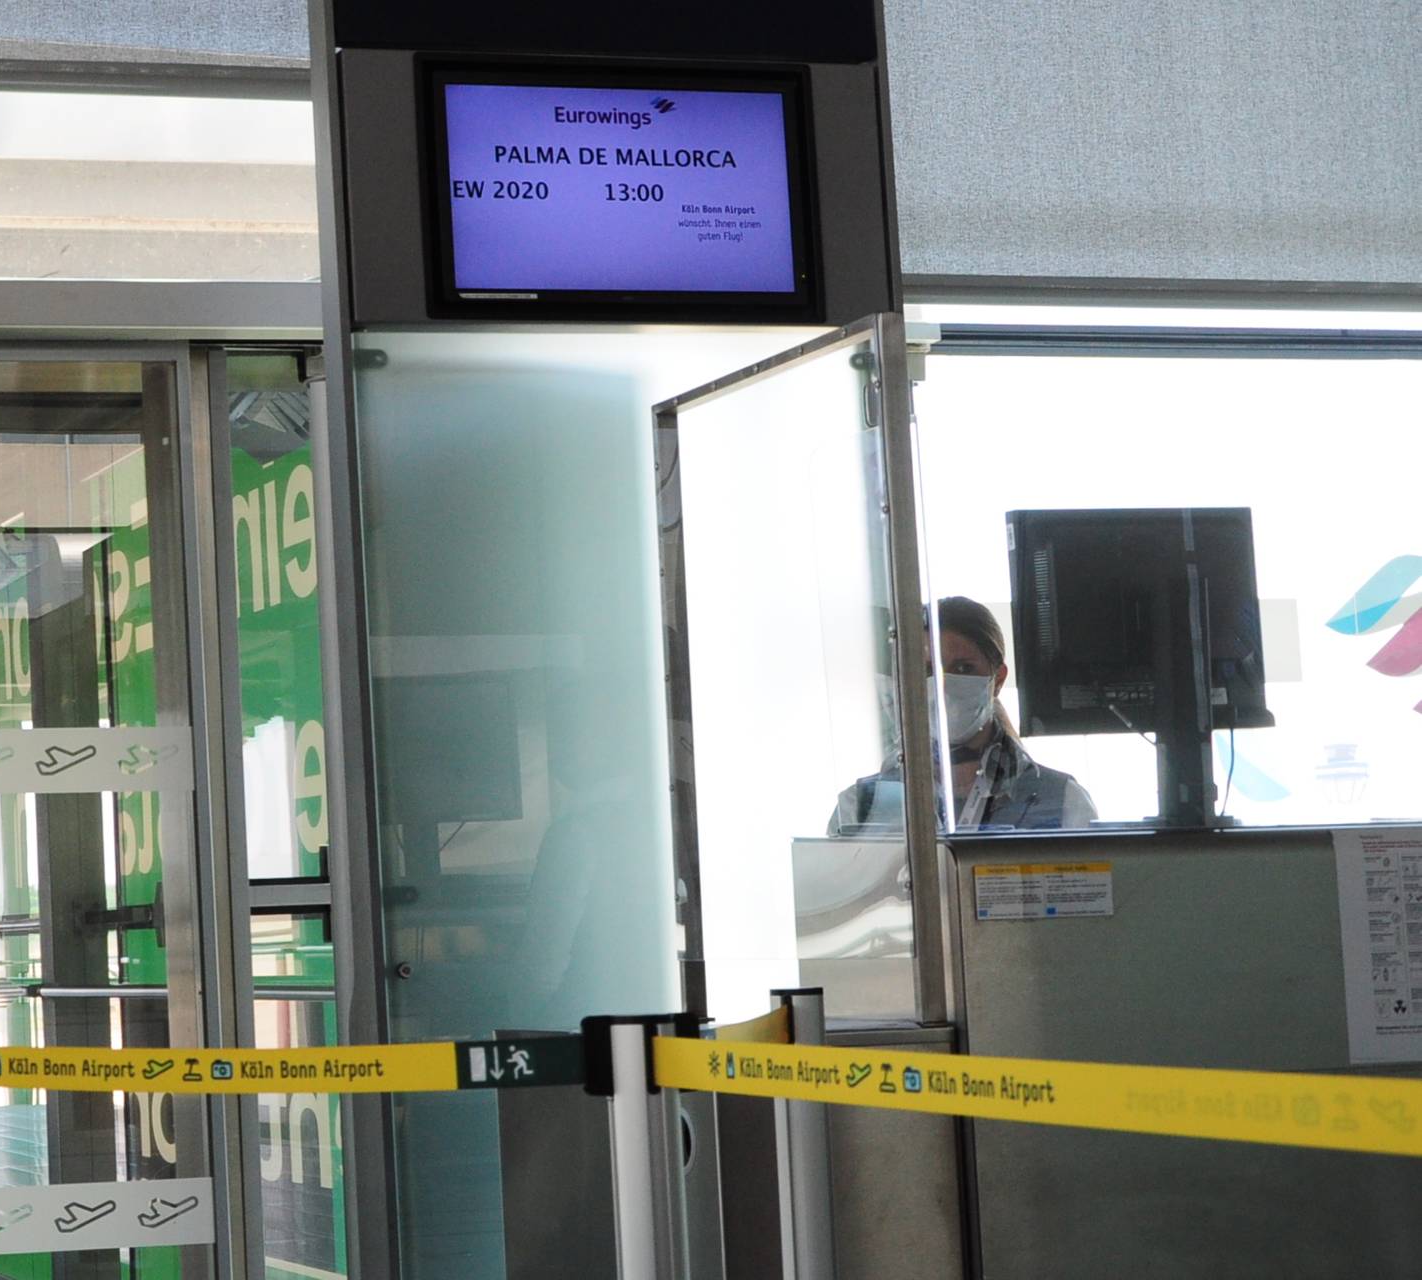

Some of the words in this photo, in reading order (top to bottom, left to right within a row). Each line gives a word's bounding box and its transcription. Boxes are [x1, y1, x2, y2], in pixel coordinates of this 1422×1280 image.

[554, 105, 652, 130] Eurowings
[494, 145, 571, 165] PALMA
[579, 147, 607, 166] DE
[616, 148, 737, 168] MALLORCA
[452, 180, 485, 199] EW
[493, 181, 549, 200] 2020
[605, 183, 664, 202] 13:00
[681, 204, 700, 214] Köln
[702, 204, 723, 214] Bonn
[724, 205, 756, 217] Airport
[678, 219, 711, 228] wünscht
[713, 219, 737, 229] Ihnen
[739, 220, 762, 229] einen
[697, 231, 721, 242] guten
[8, 1057, 38, 1076] Köln
[43, 1058, 76, 1077] Bonn
[81, 1059, 136, 1080] Airport
[240, 1060, 274, 1080] Köln
[280, 1060, 317, 1080] Bonn
[323, 1059, 384, 1082] Airport
[739, 1056, 763, 1077] Köln
[766, 1059, 794, 1081] Bonn
[796, 1061, 841, 1087] Airport
[927, 1069, 957, 1095] Köln
[962, 1073, 995, 1098] Bonn
[1001, 1075, 1055, 1107] Airport
